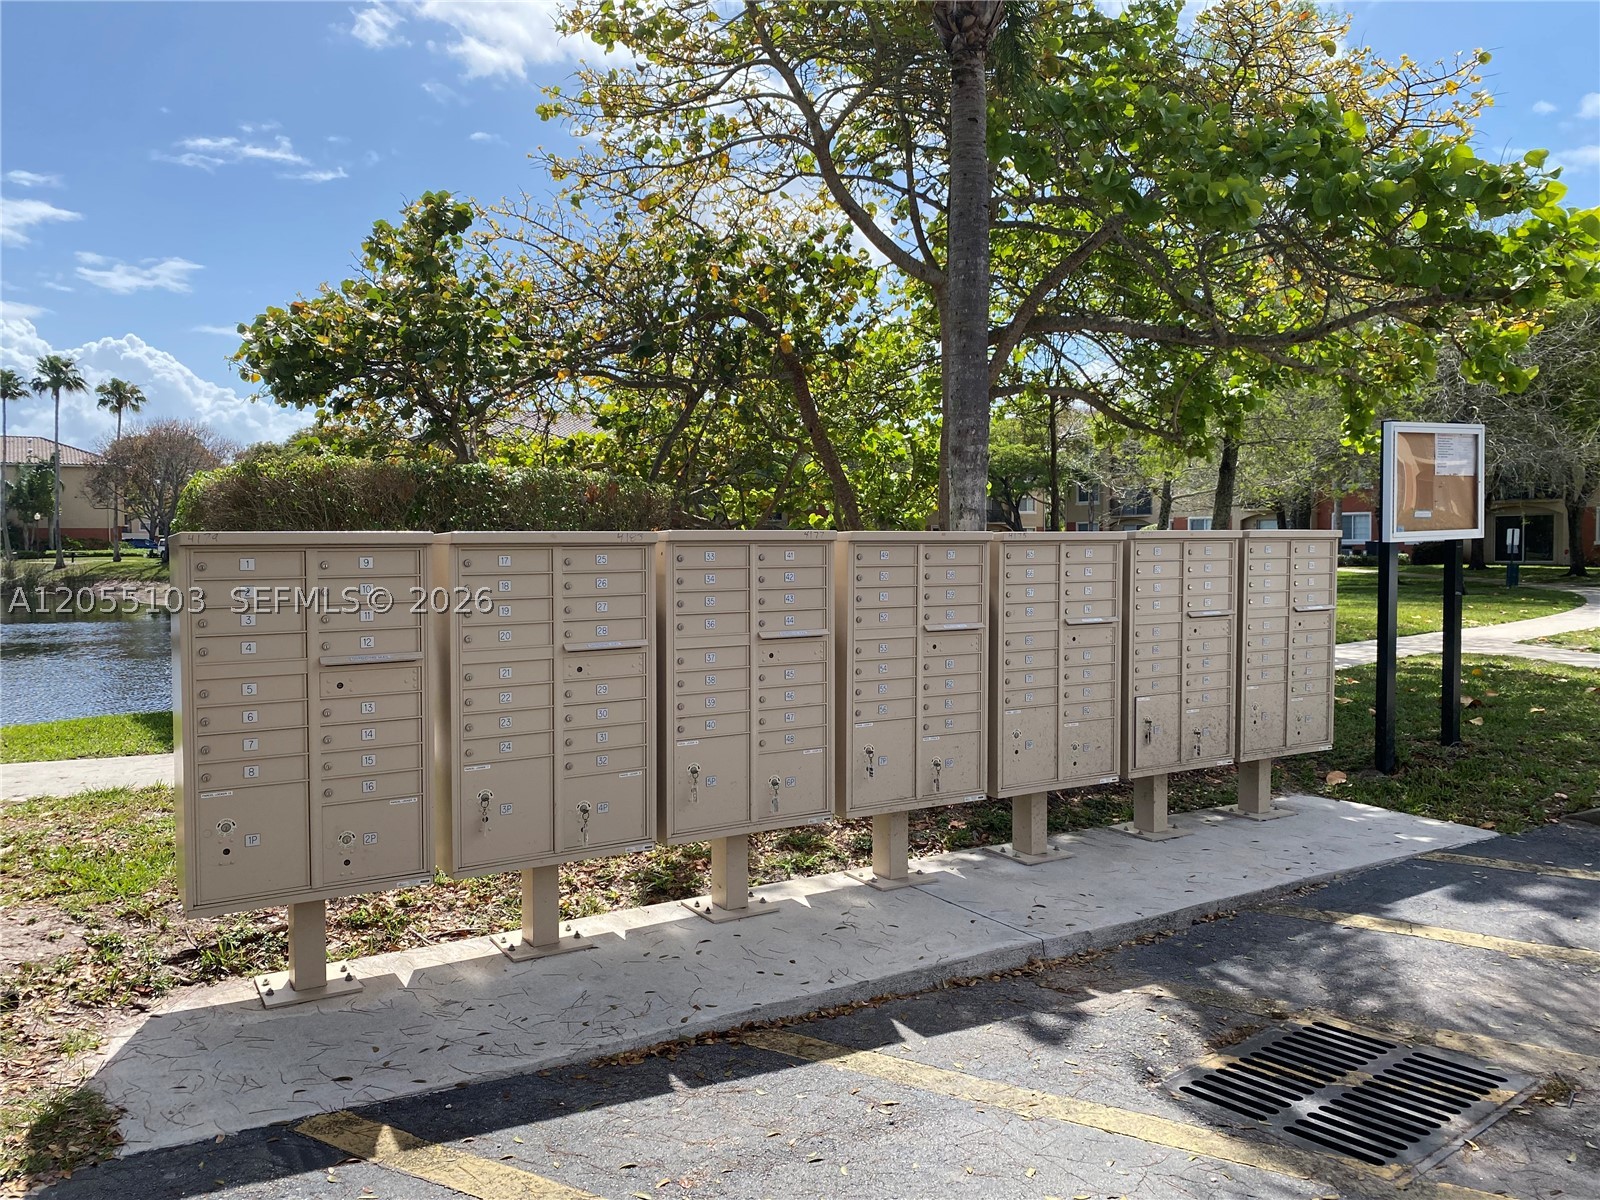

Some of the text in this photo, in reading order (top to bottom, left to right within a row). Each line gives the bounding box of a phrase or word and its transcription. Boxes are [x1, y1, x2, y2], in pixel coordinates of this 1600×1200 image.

[188, 533, 218, 544] 4179
[246, 560, 249, 568] 1
[364, 559, 369, 567] 9
[502, 582, 509, 590] 18
[245, 588, 250, 596] 2
[502, 607, 509, 615] 19
[246, 616, 251, 624] 3
[501, 632, 510, 640] 20
[364, 638, 371, 646] 12
[706, 654, 714, 662] 37
[502, 669, 510, 677] 21
[707, 676, 716, 684] 38
[247, 685, 252, 694] 5
[501, 694, 510, 702] 22
[365, 704, 373, 712] 13
[248, 713, 253, 721] 6
[501, 718, 511, 727] 23
[248, 768, 254, 776] 8
[365, 782, 374, 790] 16
[502, 805, 511, 813] 3P
[249, 836, 257, 844] 1P
[365, 834, 376, 843] 2P
